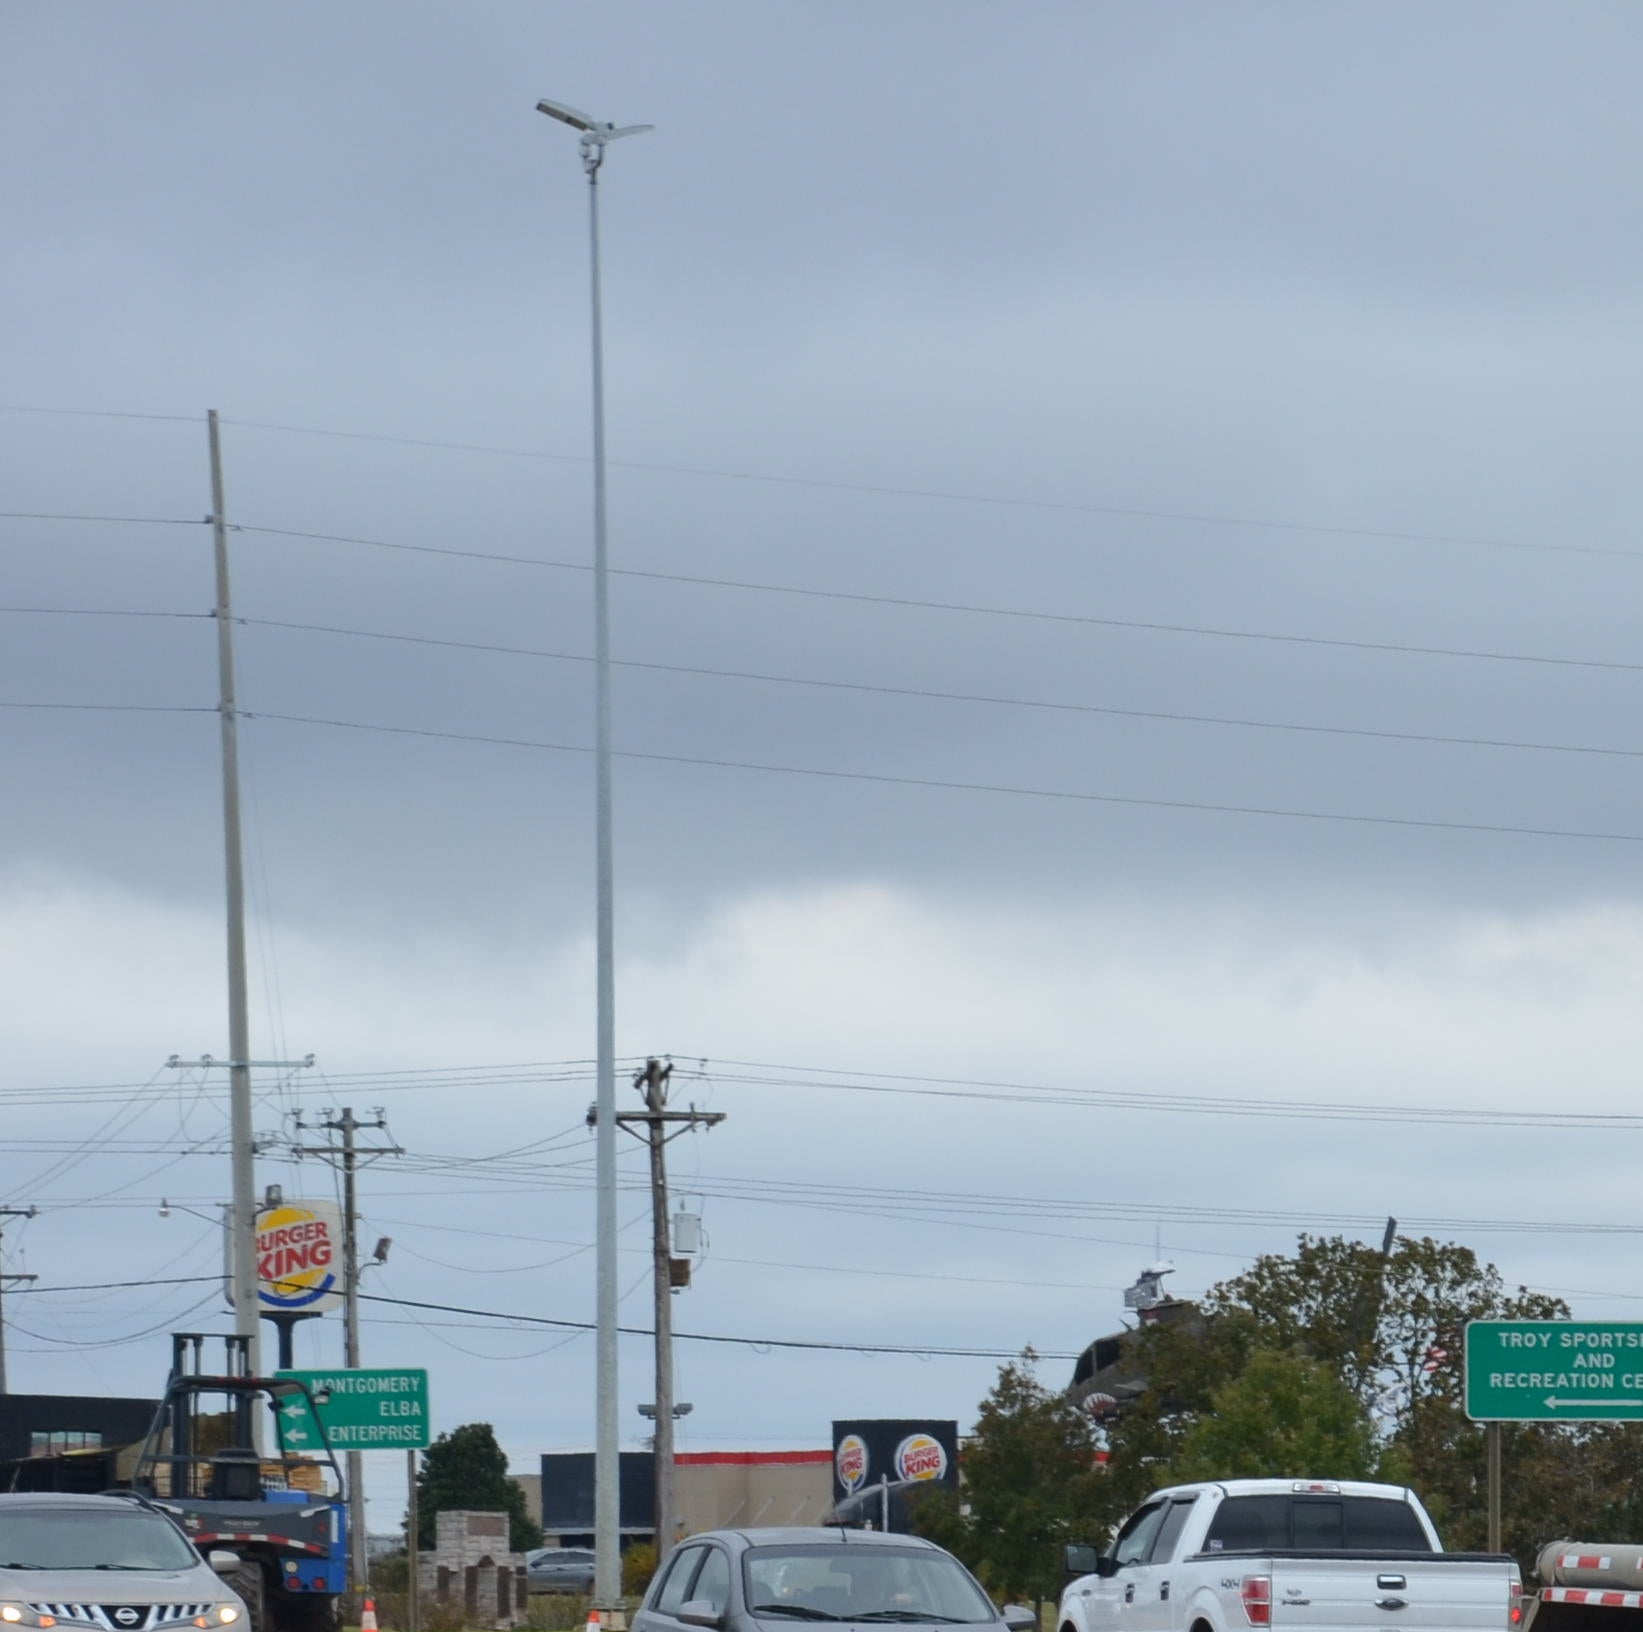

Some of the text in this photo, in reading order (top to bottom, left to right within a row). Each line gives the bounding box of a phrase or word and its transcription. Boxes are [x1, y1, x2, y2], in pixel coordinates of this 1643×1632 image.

[257, 1240, 332, 1279] KING
[1498, 1332, 1551, 1348] TROY
[1573, 1353, 1615, 1368] AND
[312, 1377, 420, 1394] MONTGOMERY
[1489, 1373, 1614, 1388] RECREATION
[380, 1401, 421, 1416] ELBA
[328, 1425, 421, 1442] ENTERPRISE
[905, 1456, 940, 1476] KING
